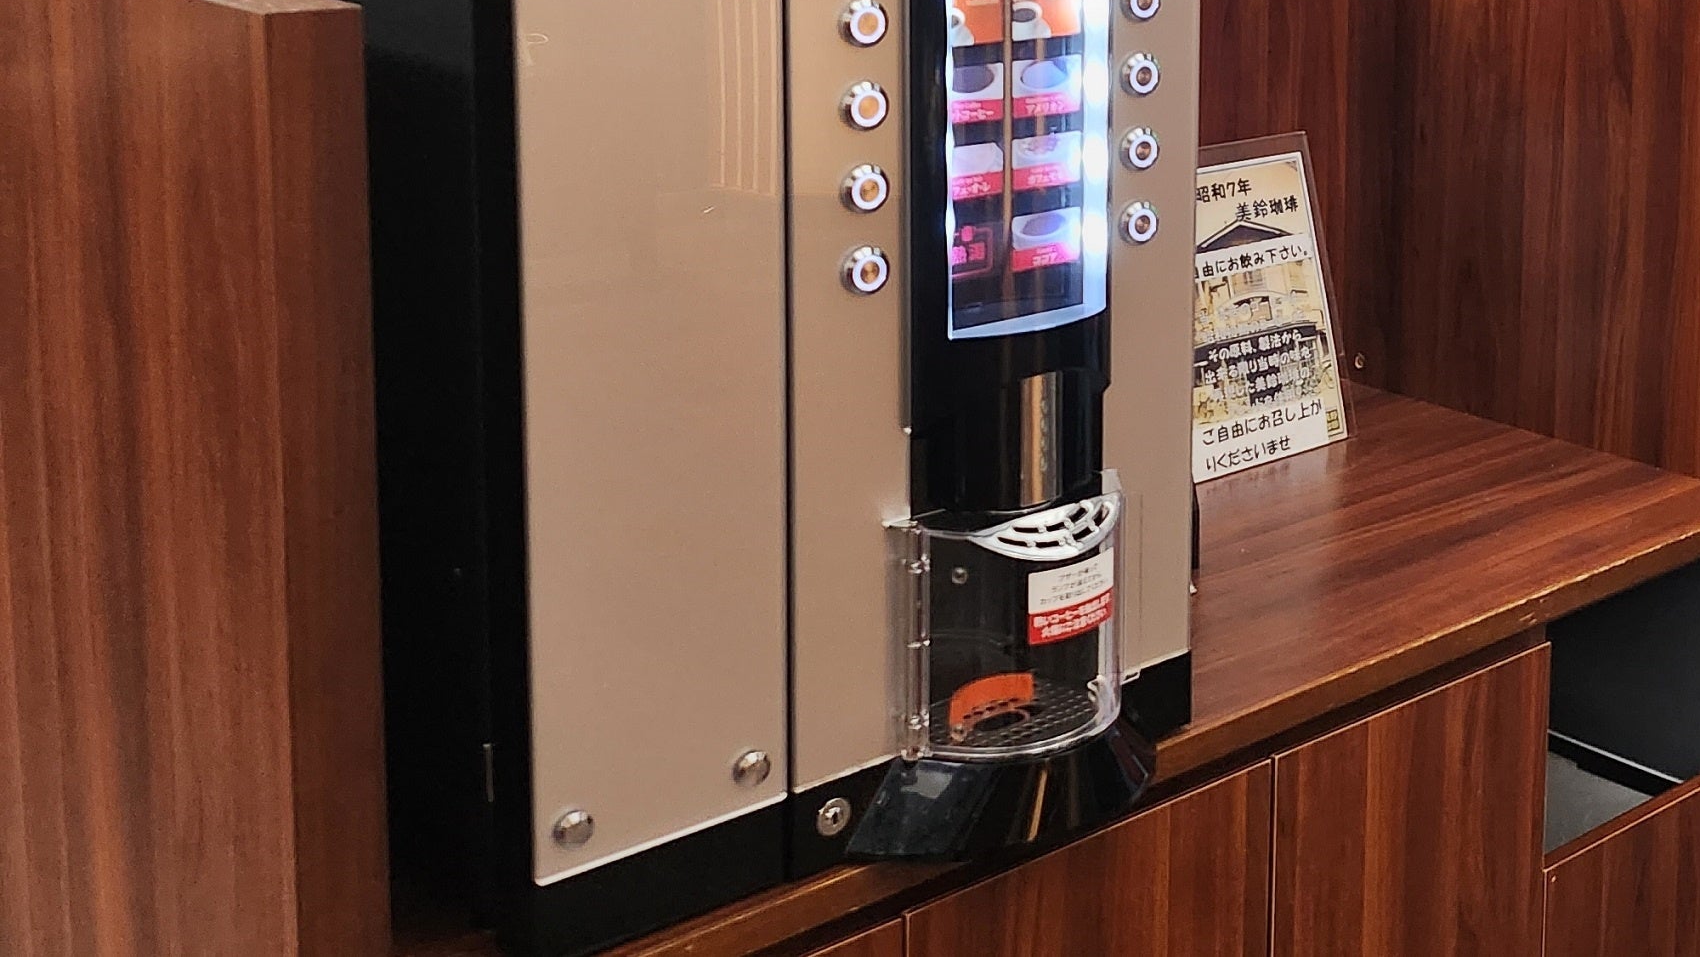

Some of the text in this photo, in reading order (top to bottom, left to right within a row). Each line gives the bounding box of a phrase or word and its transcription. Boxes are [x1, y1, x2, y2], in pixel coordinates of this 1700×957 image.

[1196, 178, 1252, 204] 昭和7年
[1235, 195, 1299, 222] 美鈴珈琲
[1205, 435, 1292, 473] りくださいませ
